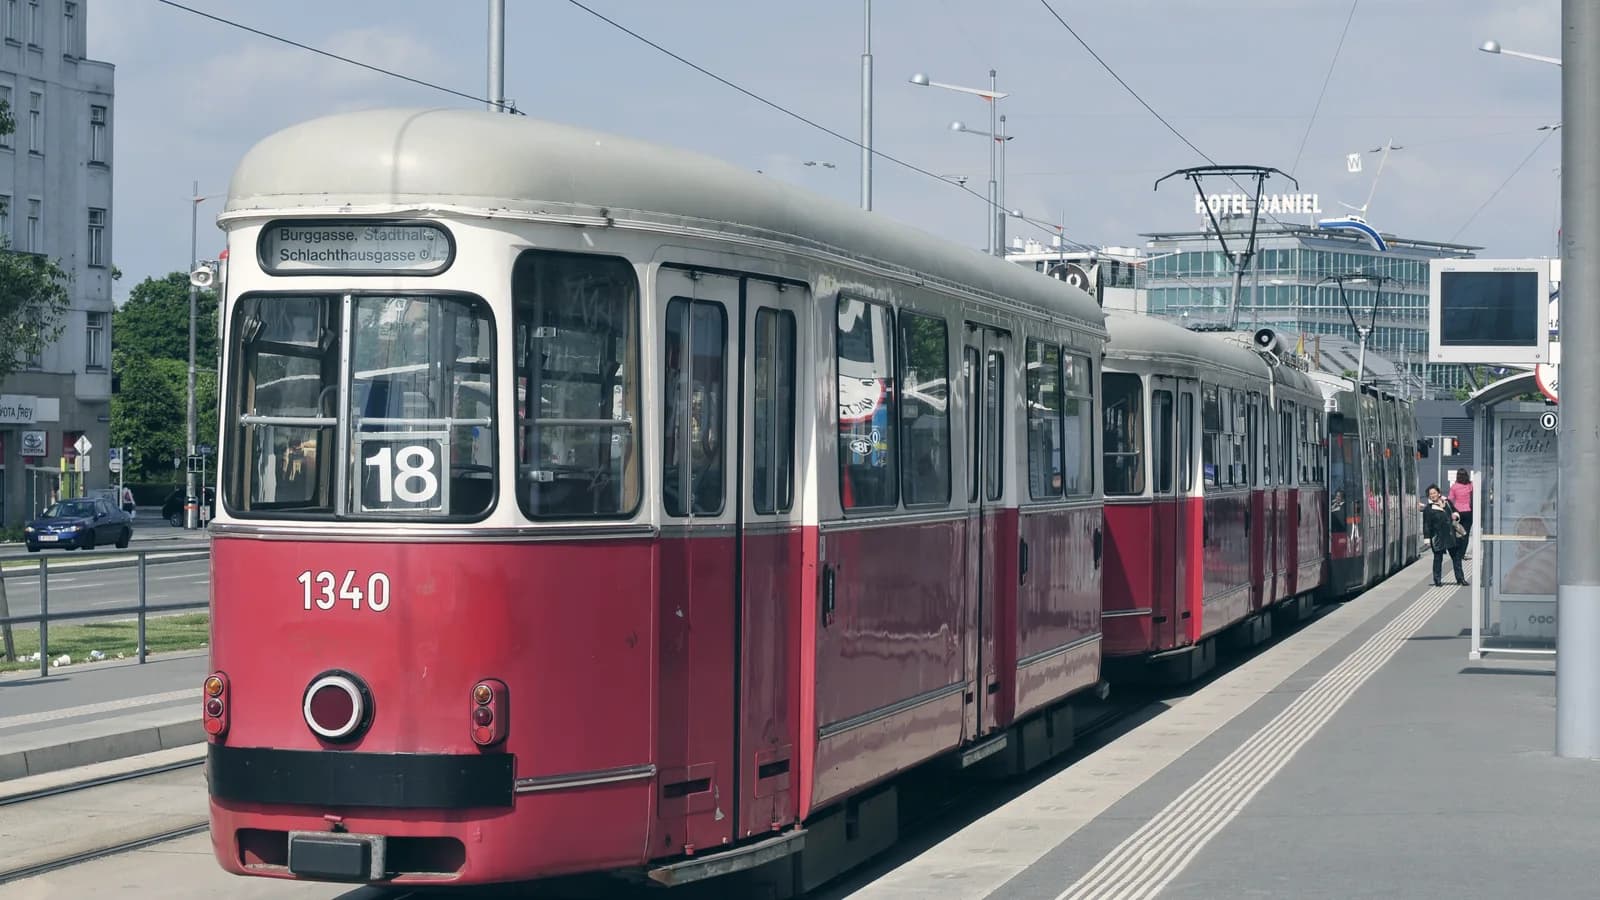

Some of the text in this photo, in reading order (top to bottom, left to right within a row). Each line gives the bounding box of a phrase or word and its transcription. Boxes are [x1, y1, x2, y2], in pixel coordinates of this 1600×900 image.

[1195, 193, 1322, 214] HOTEL DANIEL
[280, 249, 415, 264] Schlachthausgasse
[366, 445, 438, 503] 18
[297, 569, 391, 612] 1340
